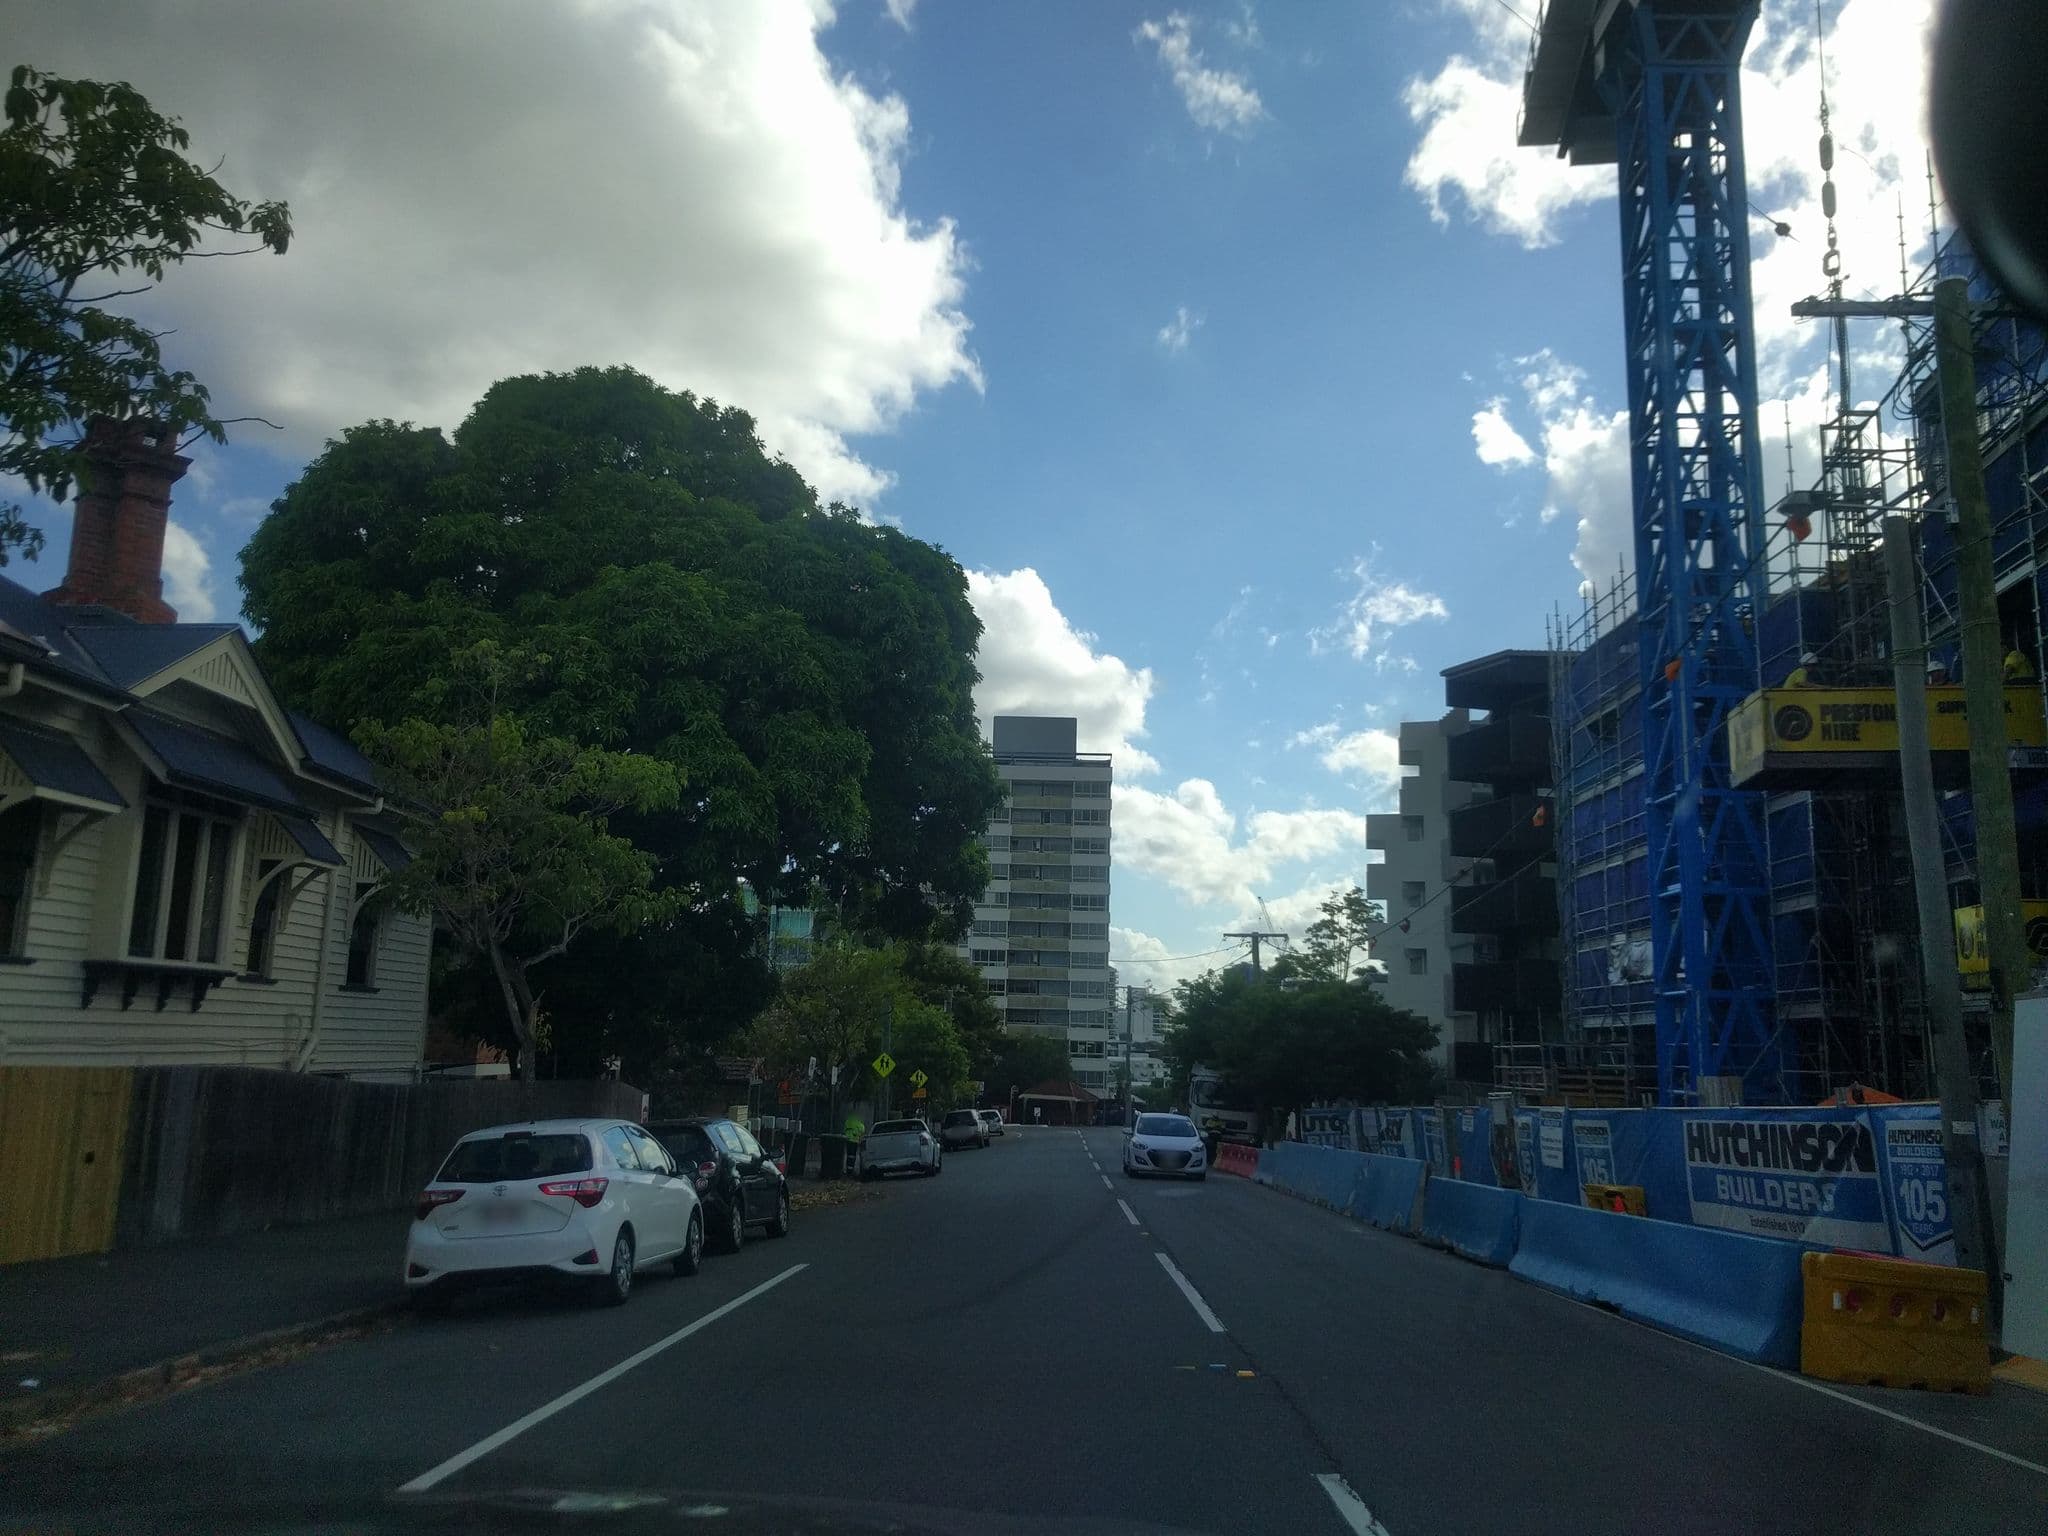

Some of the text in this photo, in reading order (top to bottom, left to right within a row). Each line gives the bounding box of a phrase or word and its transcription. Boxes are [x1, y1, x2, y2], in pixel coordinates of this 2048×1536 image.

[1687, 1122, 1876, 1173] HUTCHINSON
[1888, 1129, 1944, 1144] HUTCHINSO
[1716, 1174, 1836, 1212] BUILDERS
[1900, 1178, 1946, 1222] 105
